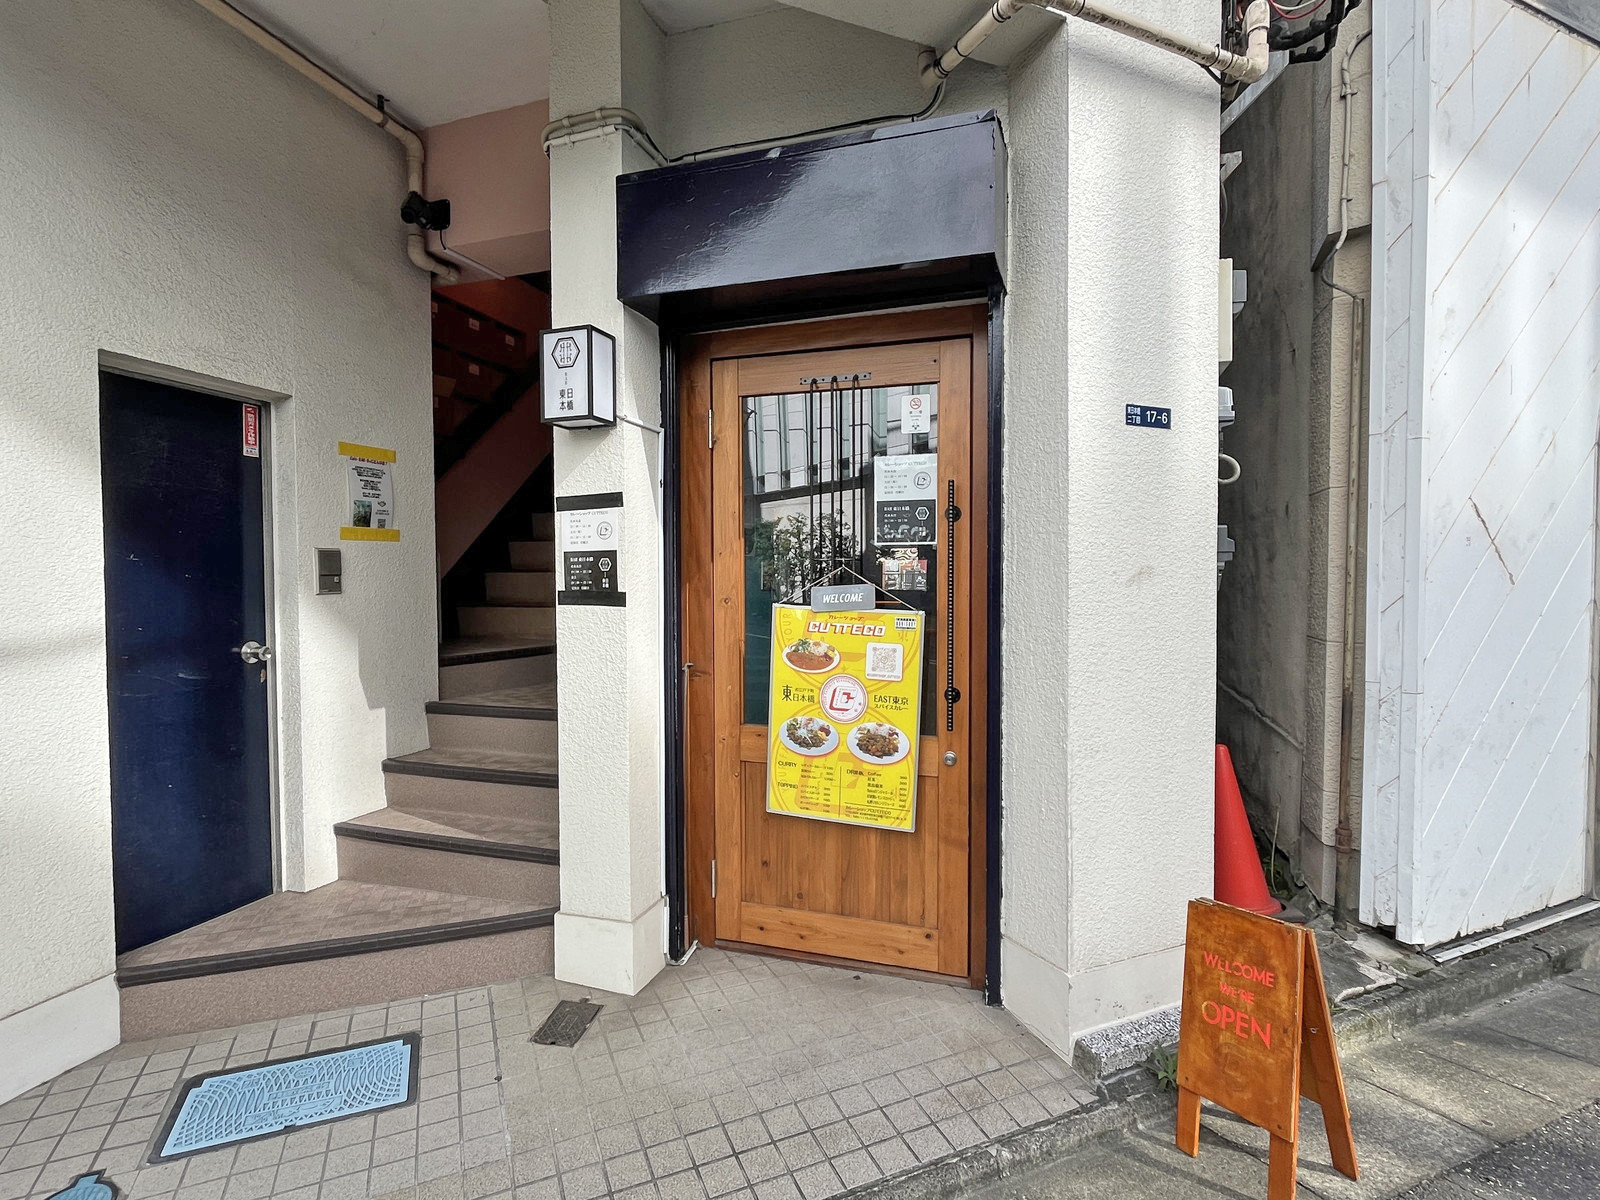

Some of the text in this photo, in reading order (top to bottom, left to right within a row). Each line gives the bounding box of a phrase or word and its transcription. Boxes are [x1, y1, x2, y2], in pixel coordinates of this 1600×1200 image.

[1146, 410, 1168, 424] 17-6
[823, 593, 864, 604] WELCOME
[808, 621, 887, 637] CUTTECO
[846, 768, 864, 776] DRINK
[1203, 951, 1275, 988] WELCOME
[1219, 981, 1255, 1006] WE'RE
[1201, 1001, 1271, 1050] OPEN
